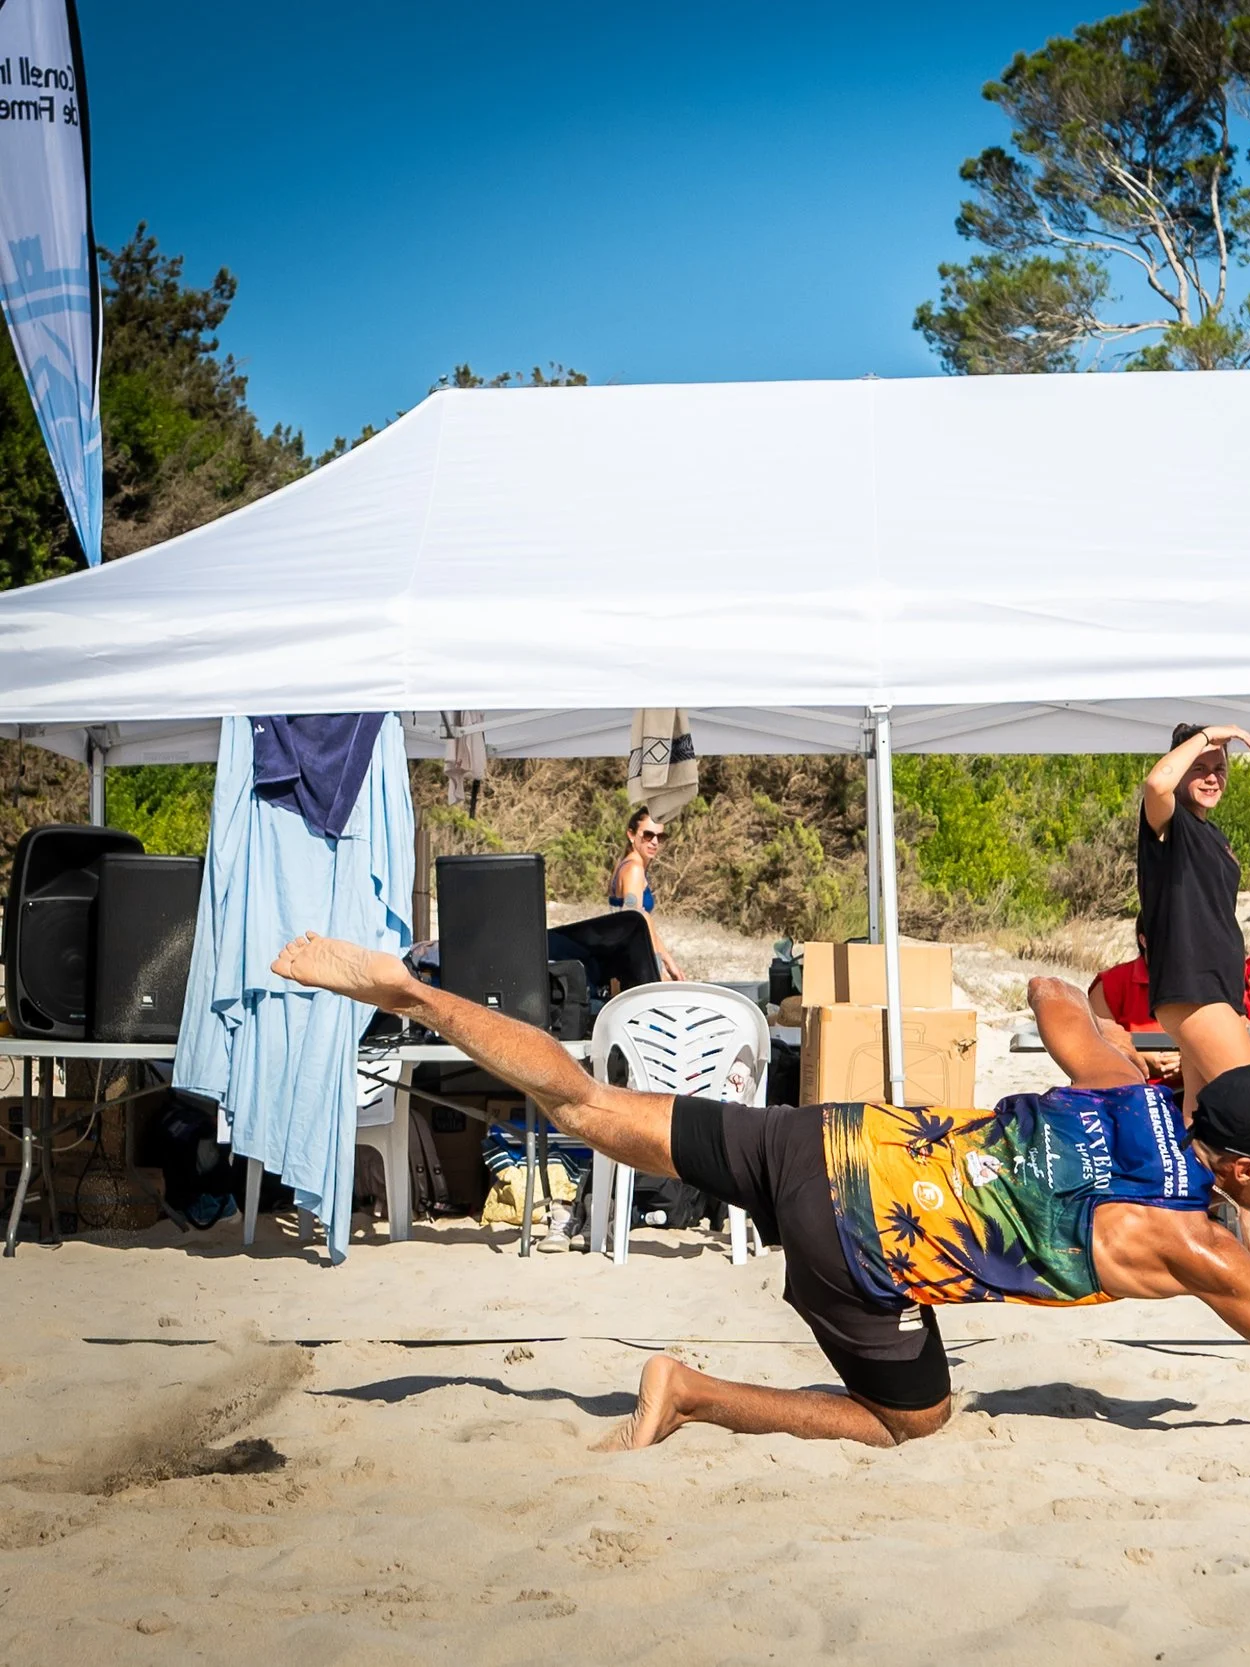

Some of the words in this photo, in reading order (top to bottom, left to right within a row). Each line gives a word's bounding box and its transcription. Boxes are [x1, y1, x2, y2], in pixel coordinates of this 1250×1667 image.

[1144, 1088, 1155, 1109] LIGA
[1149, 1109, 1174, 1174] BEACHVOLLEY
[1075, 1142, 1094, 1180] HOMES
